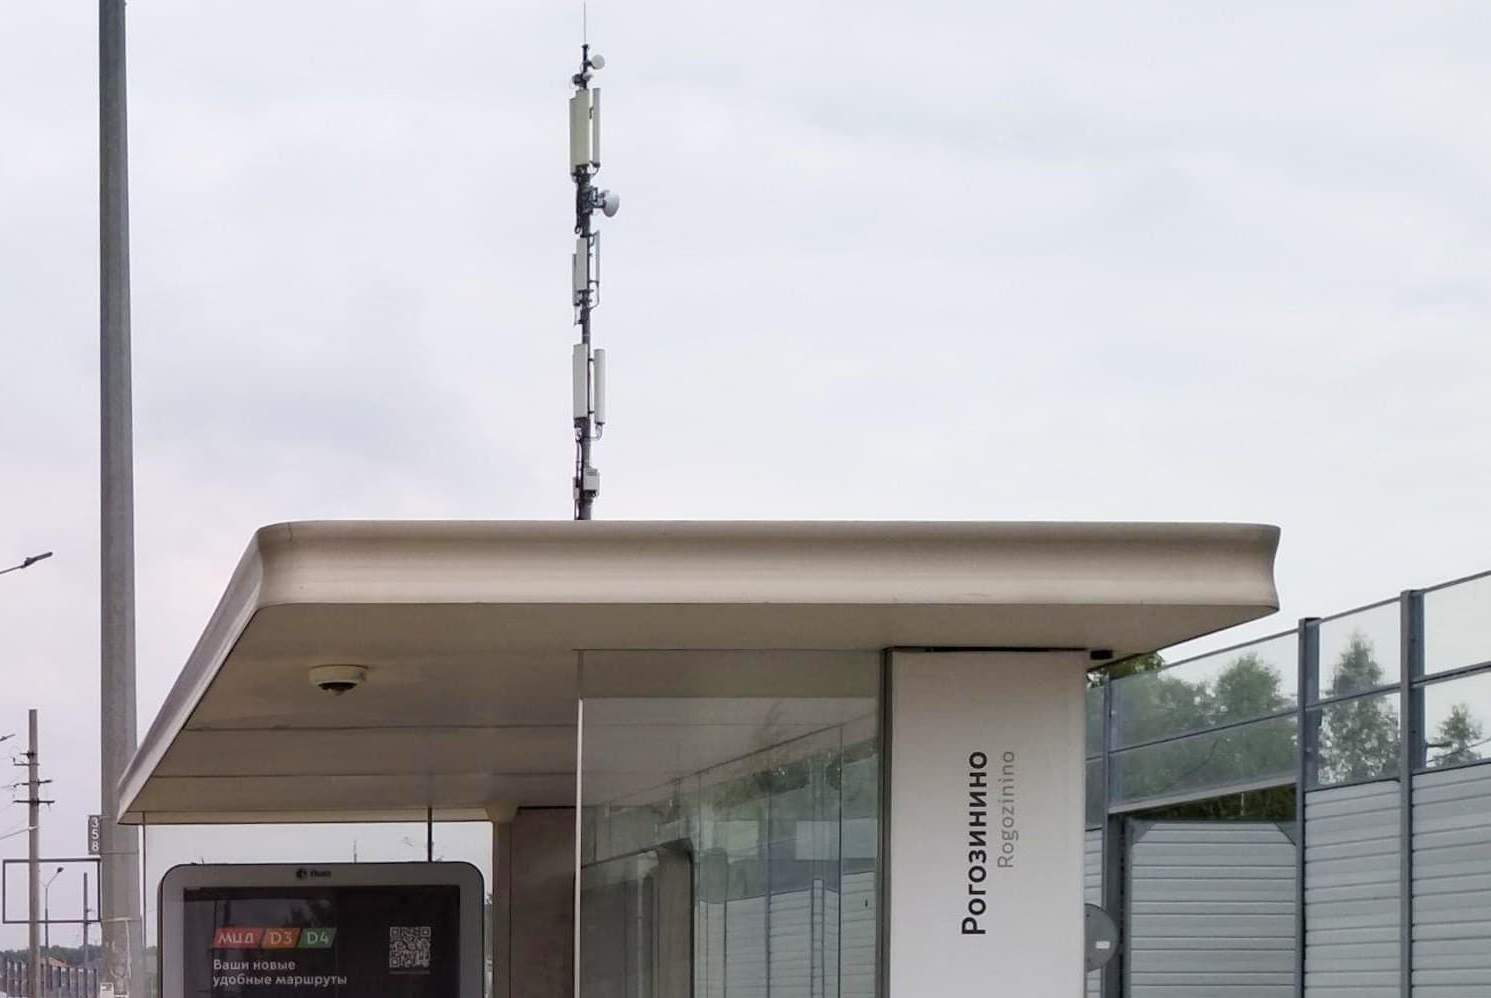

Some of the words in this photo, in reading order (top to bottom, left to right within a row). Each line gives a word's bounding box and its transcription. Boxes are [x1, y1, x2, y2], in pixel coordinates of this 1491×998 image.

[997, 751, 1018, 868] Rogozinino
[91, 816, 99, 851] 358
[962, 751, 987, 934] Рогозинино
[270, 932, 292, 944] D3
[307, 931, 328, 944] D4
[213, 959, 249, 970] Ваши
[253, 961, 296, 970] новые
[213, 973, 272, 986] удобные
[275, 975, 348, 987] маршруты
